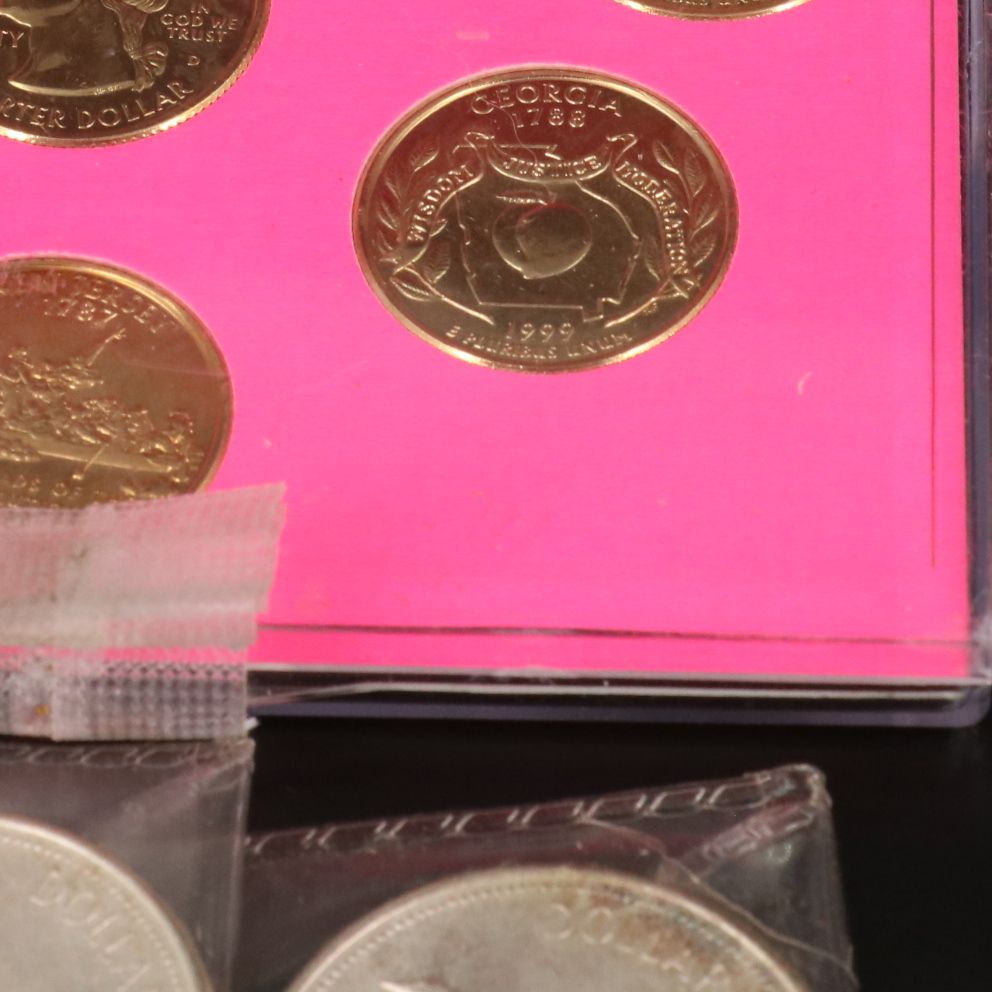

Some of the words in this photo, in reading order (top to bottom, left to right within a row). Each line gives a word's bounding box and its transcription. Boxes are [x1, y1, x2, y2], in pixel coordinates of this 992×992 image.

[160, 13, 204, 27] GOD
[211, 16, 239, 30] WE
[167, 27, 228, 43] TRUST
[75, 80, 196, 131] DOLLAR
[469, 82, 624, 118] GEORGIA
[510, 107, 588, 130] 1788
[407, 164, 475, 242] WISDOM
[506, 321, 576, 344] 1999
[29, 870, 155, 992] DOLLA
